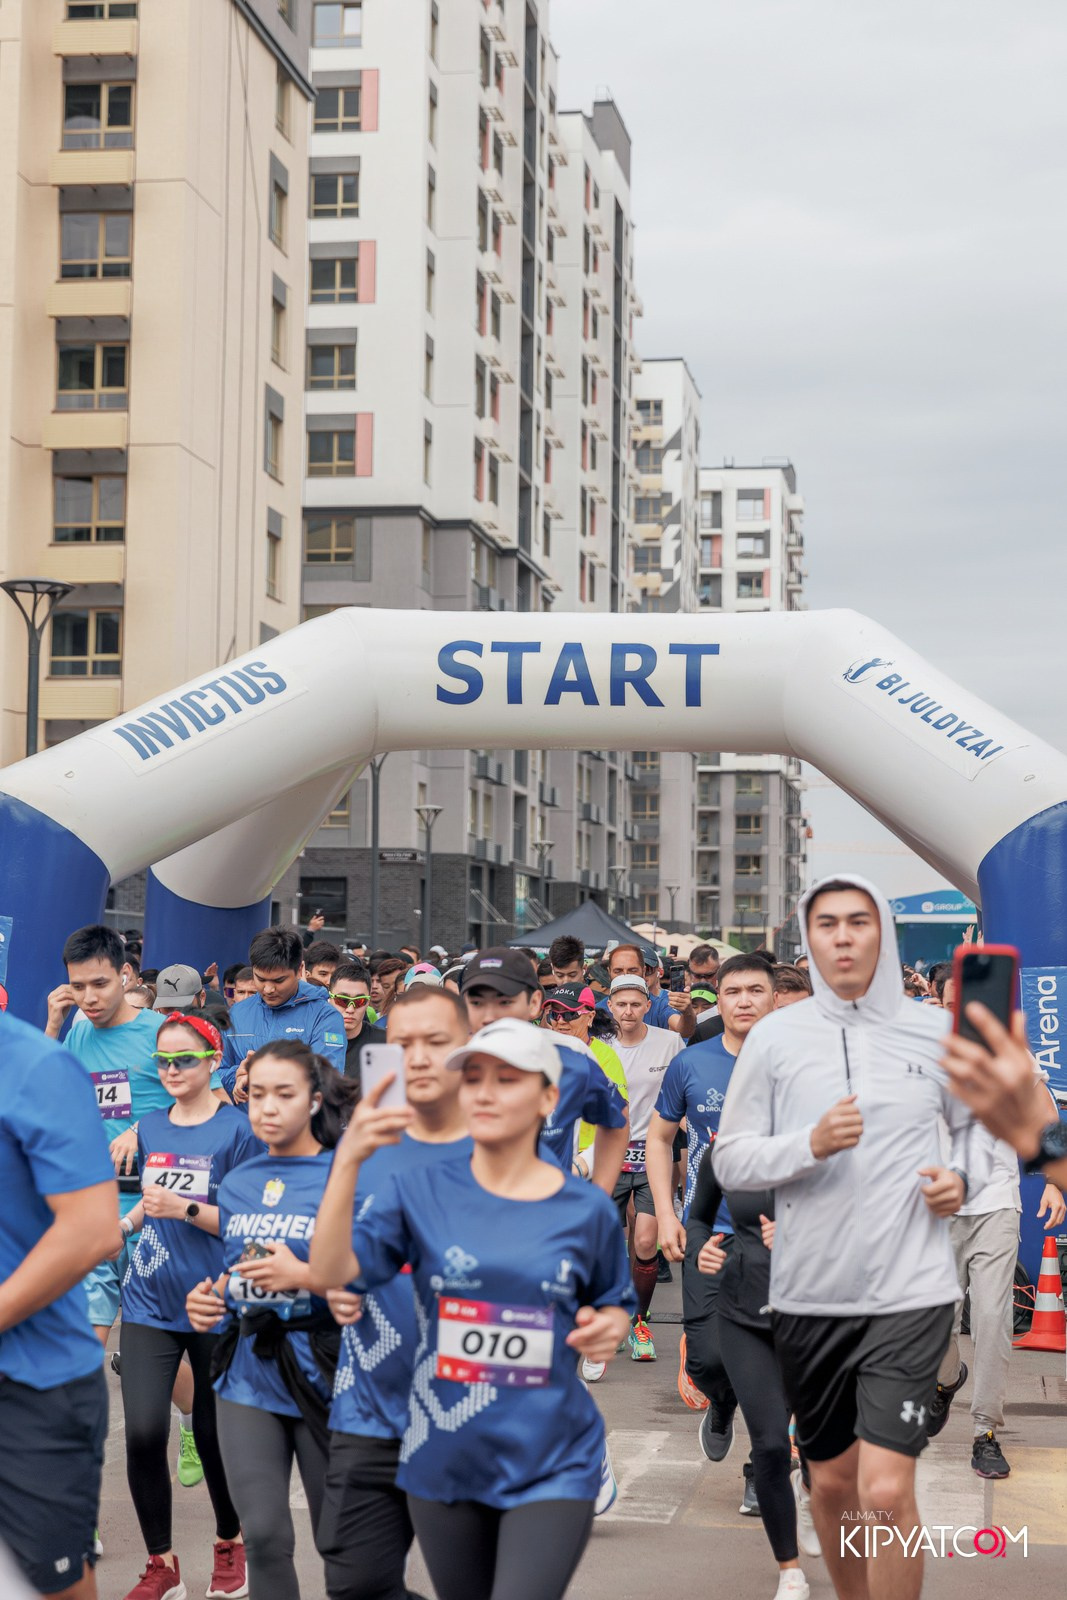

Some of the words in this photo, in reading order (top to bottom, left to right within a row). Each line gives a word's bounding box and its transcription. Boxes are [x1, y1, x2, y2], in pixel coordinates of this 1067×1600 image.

[436, 640, 720, 707] START
[112, 661, 287, 761] INVICTUS
[875, 673, 911, 696] BI
[897, 692, 1004, 760] JULDYZAI
[934, 903, 962, 911] GROUP
[1035, 975, 1061, 1069] Arena
[154, 1171, 195, 1190] 472
[462, 1331, 527, 1360] 010
